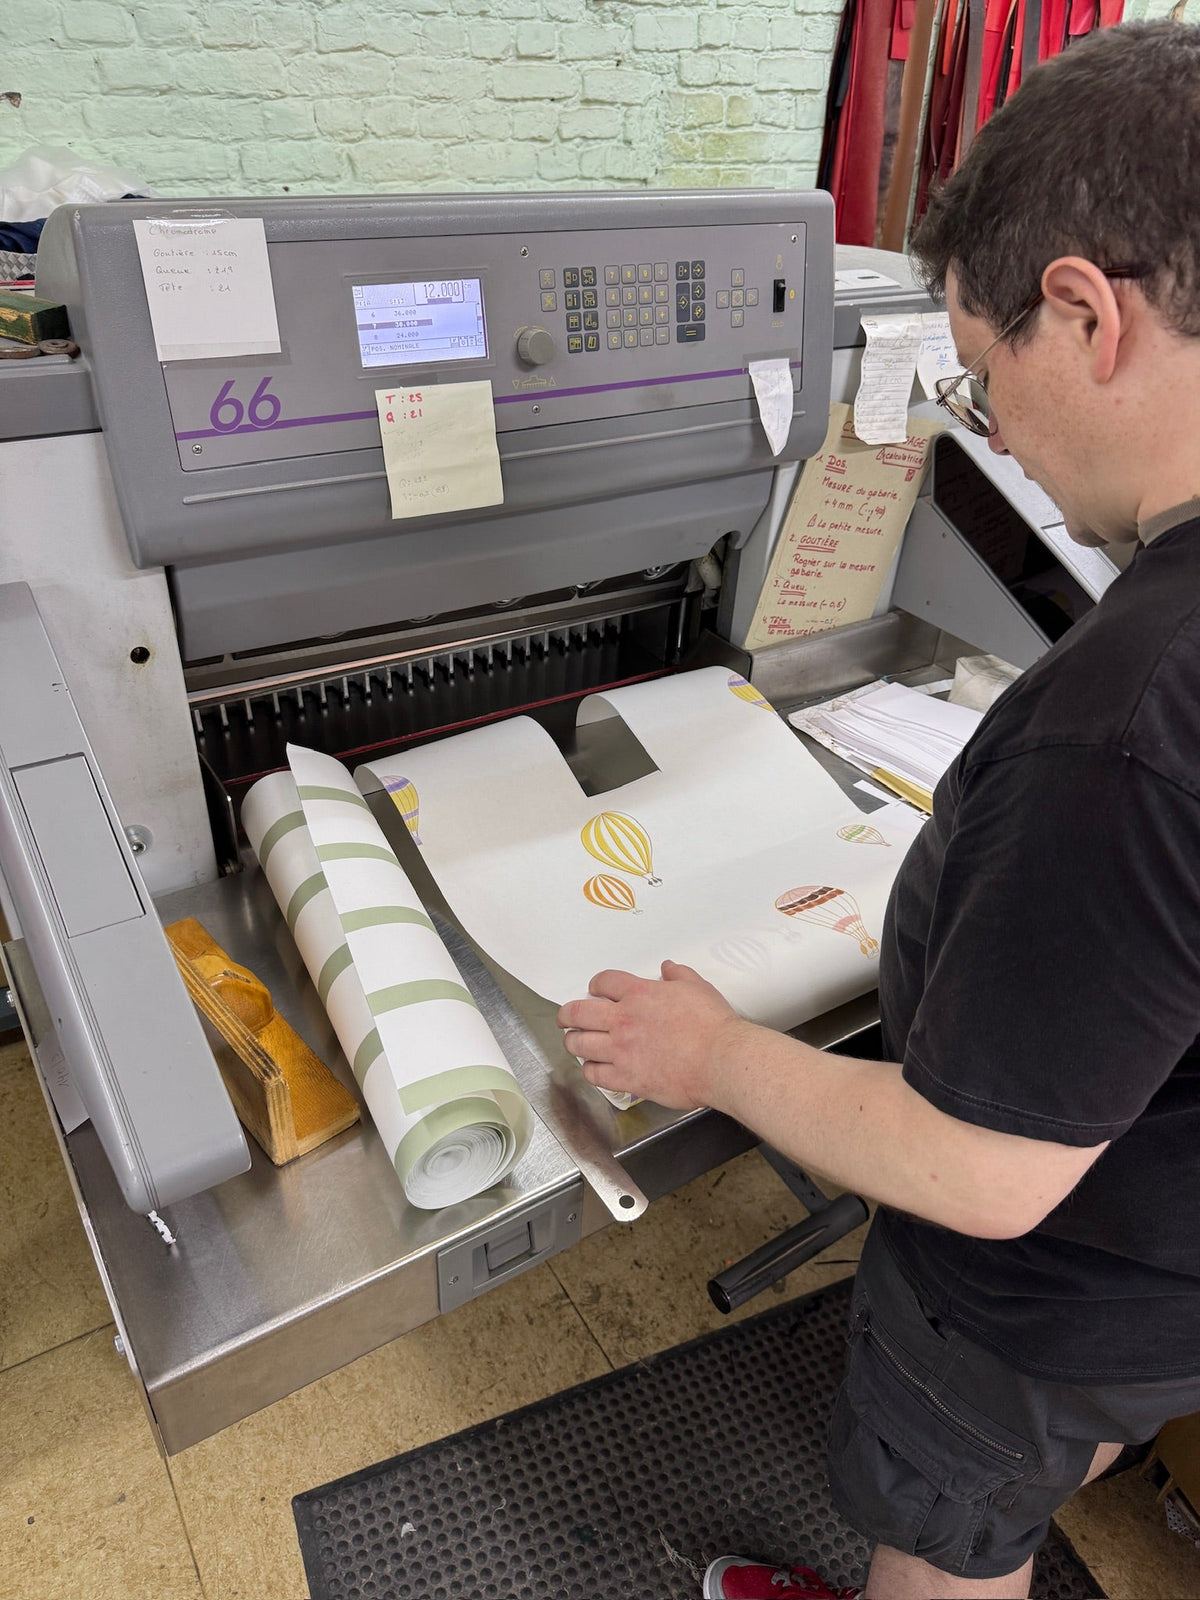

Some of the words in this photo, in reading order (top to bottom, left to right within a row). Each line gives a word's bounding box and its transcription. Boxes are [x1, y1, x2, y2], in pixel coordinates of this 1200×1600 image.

[424, 282, 460, 298] 12.000
[209, 375, 281, 433] 66
[385, 394, 396, 405] T
[849, 563, 876, 572] mesure
